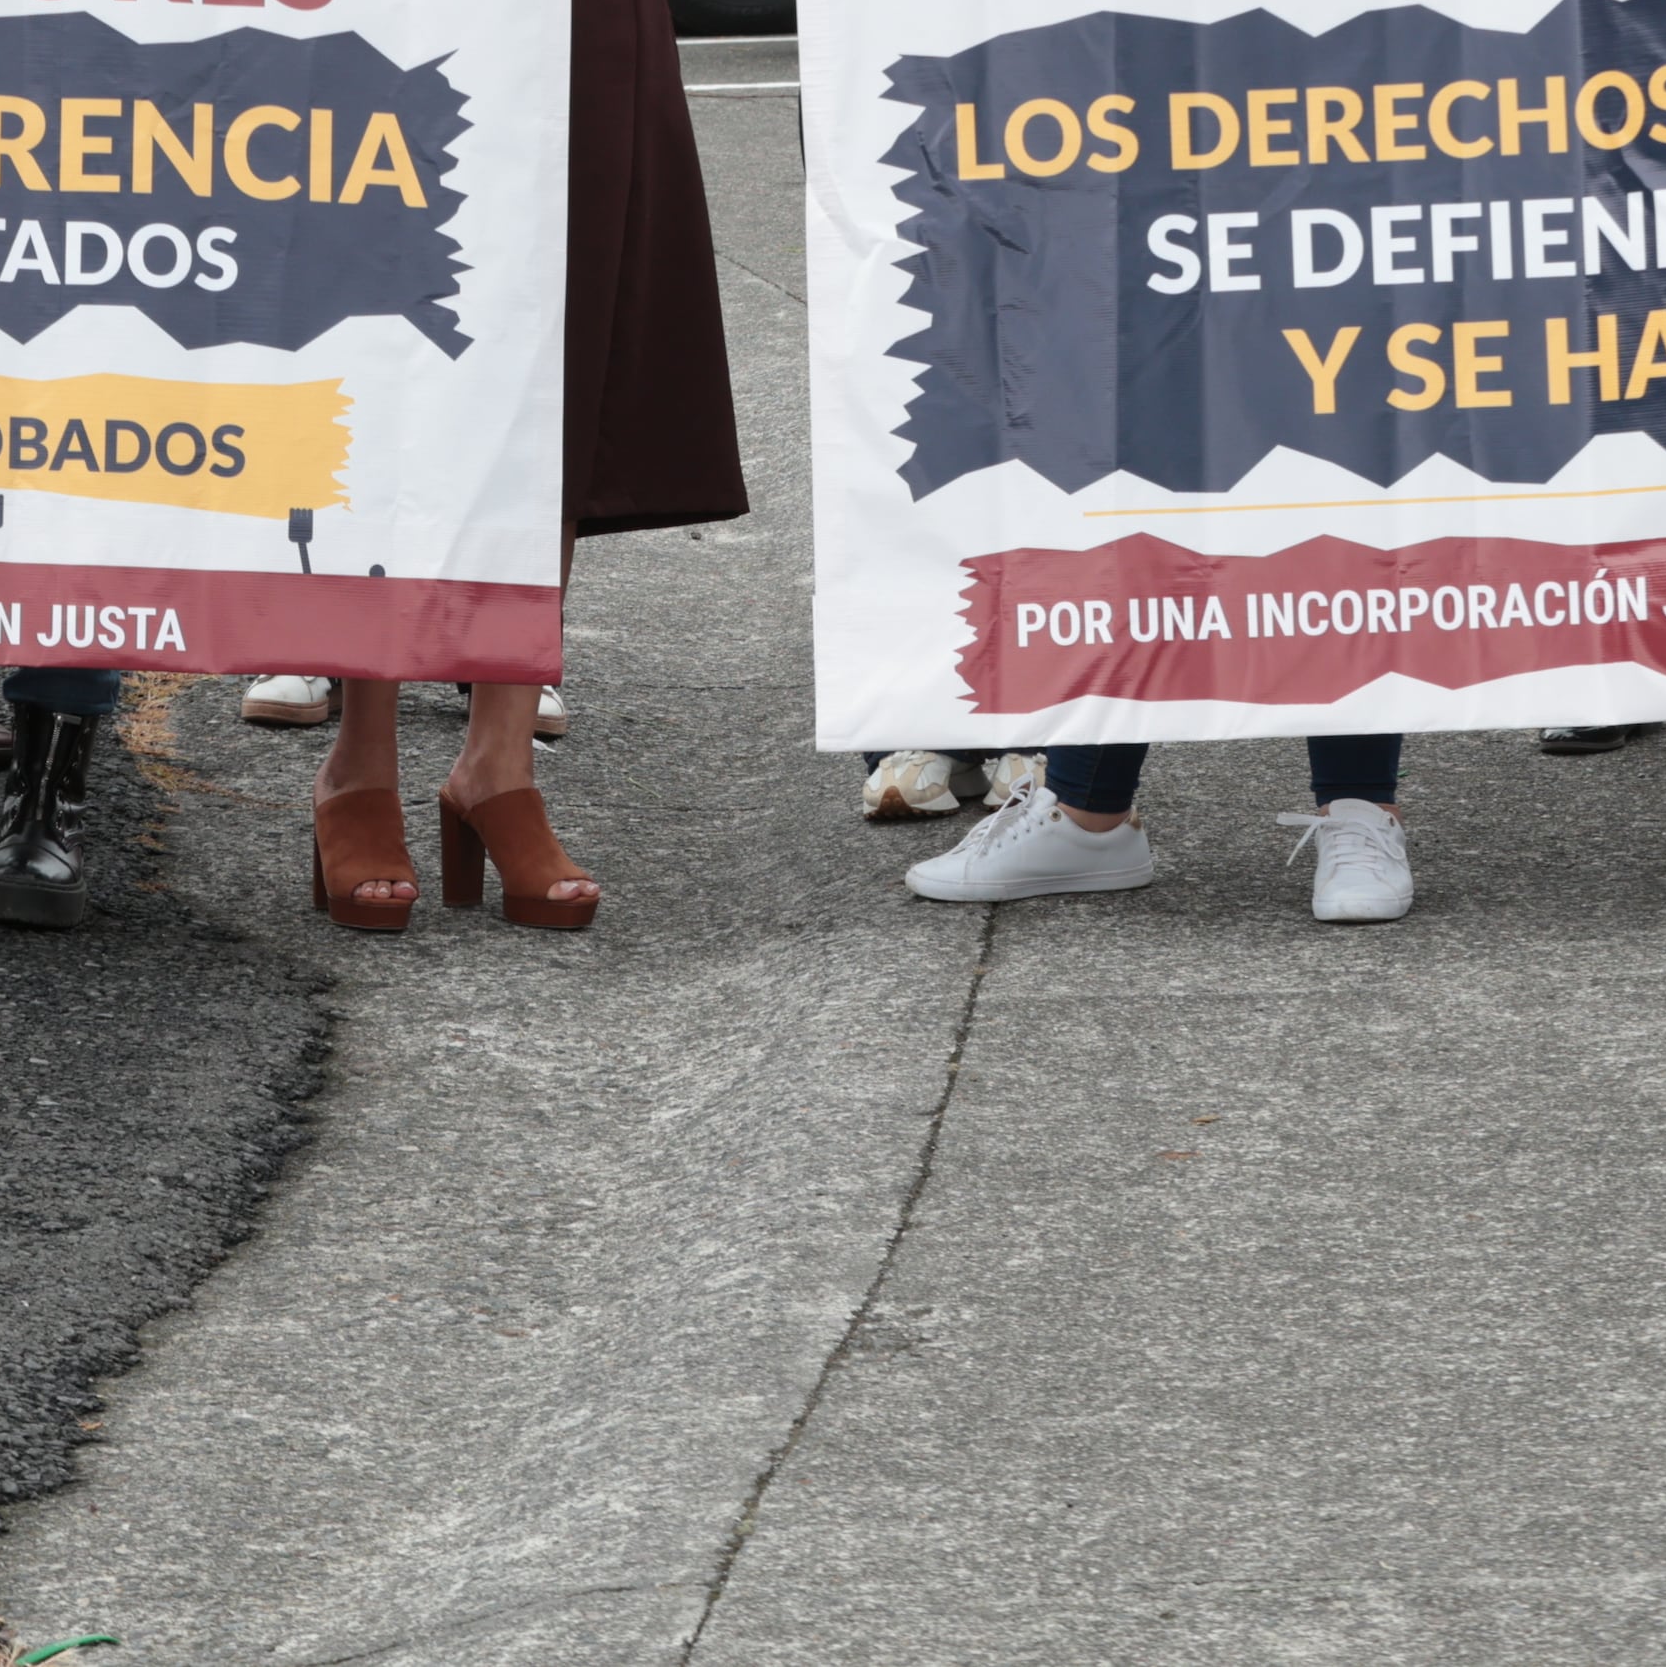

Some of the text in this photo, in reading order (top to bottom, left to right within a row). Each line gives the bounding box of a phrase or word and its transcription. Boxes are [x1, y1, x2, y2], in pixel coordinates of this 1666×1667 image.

[957, 95, 1139, 179] LOS
[1147, 212, 1261, 294] SE
[1285, 328, 1361, 413] Y
[1387, 321, 1512, 410] SE
[37, 604, 186, 651] JUSTA
[1017, 600, 1113, 647] POR
[1129, 596, 1232, 642] UNA
[1247, 568, 1648, 638] INCORPORACIÓN
